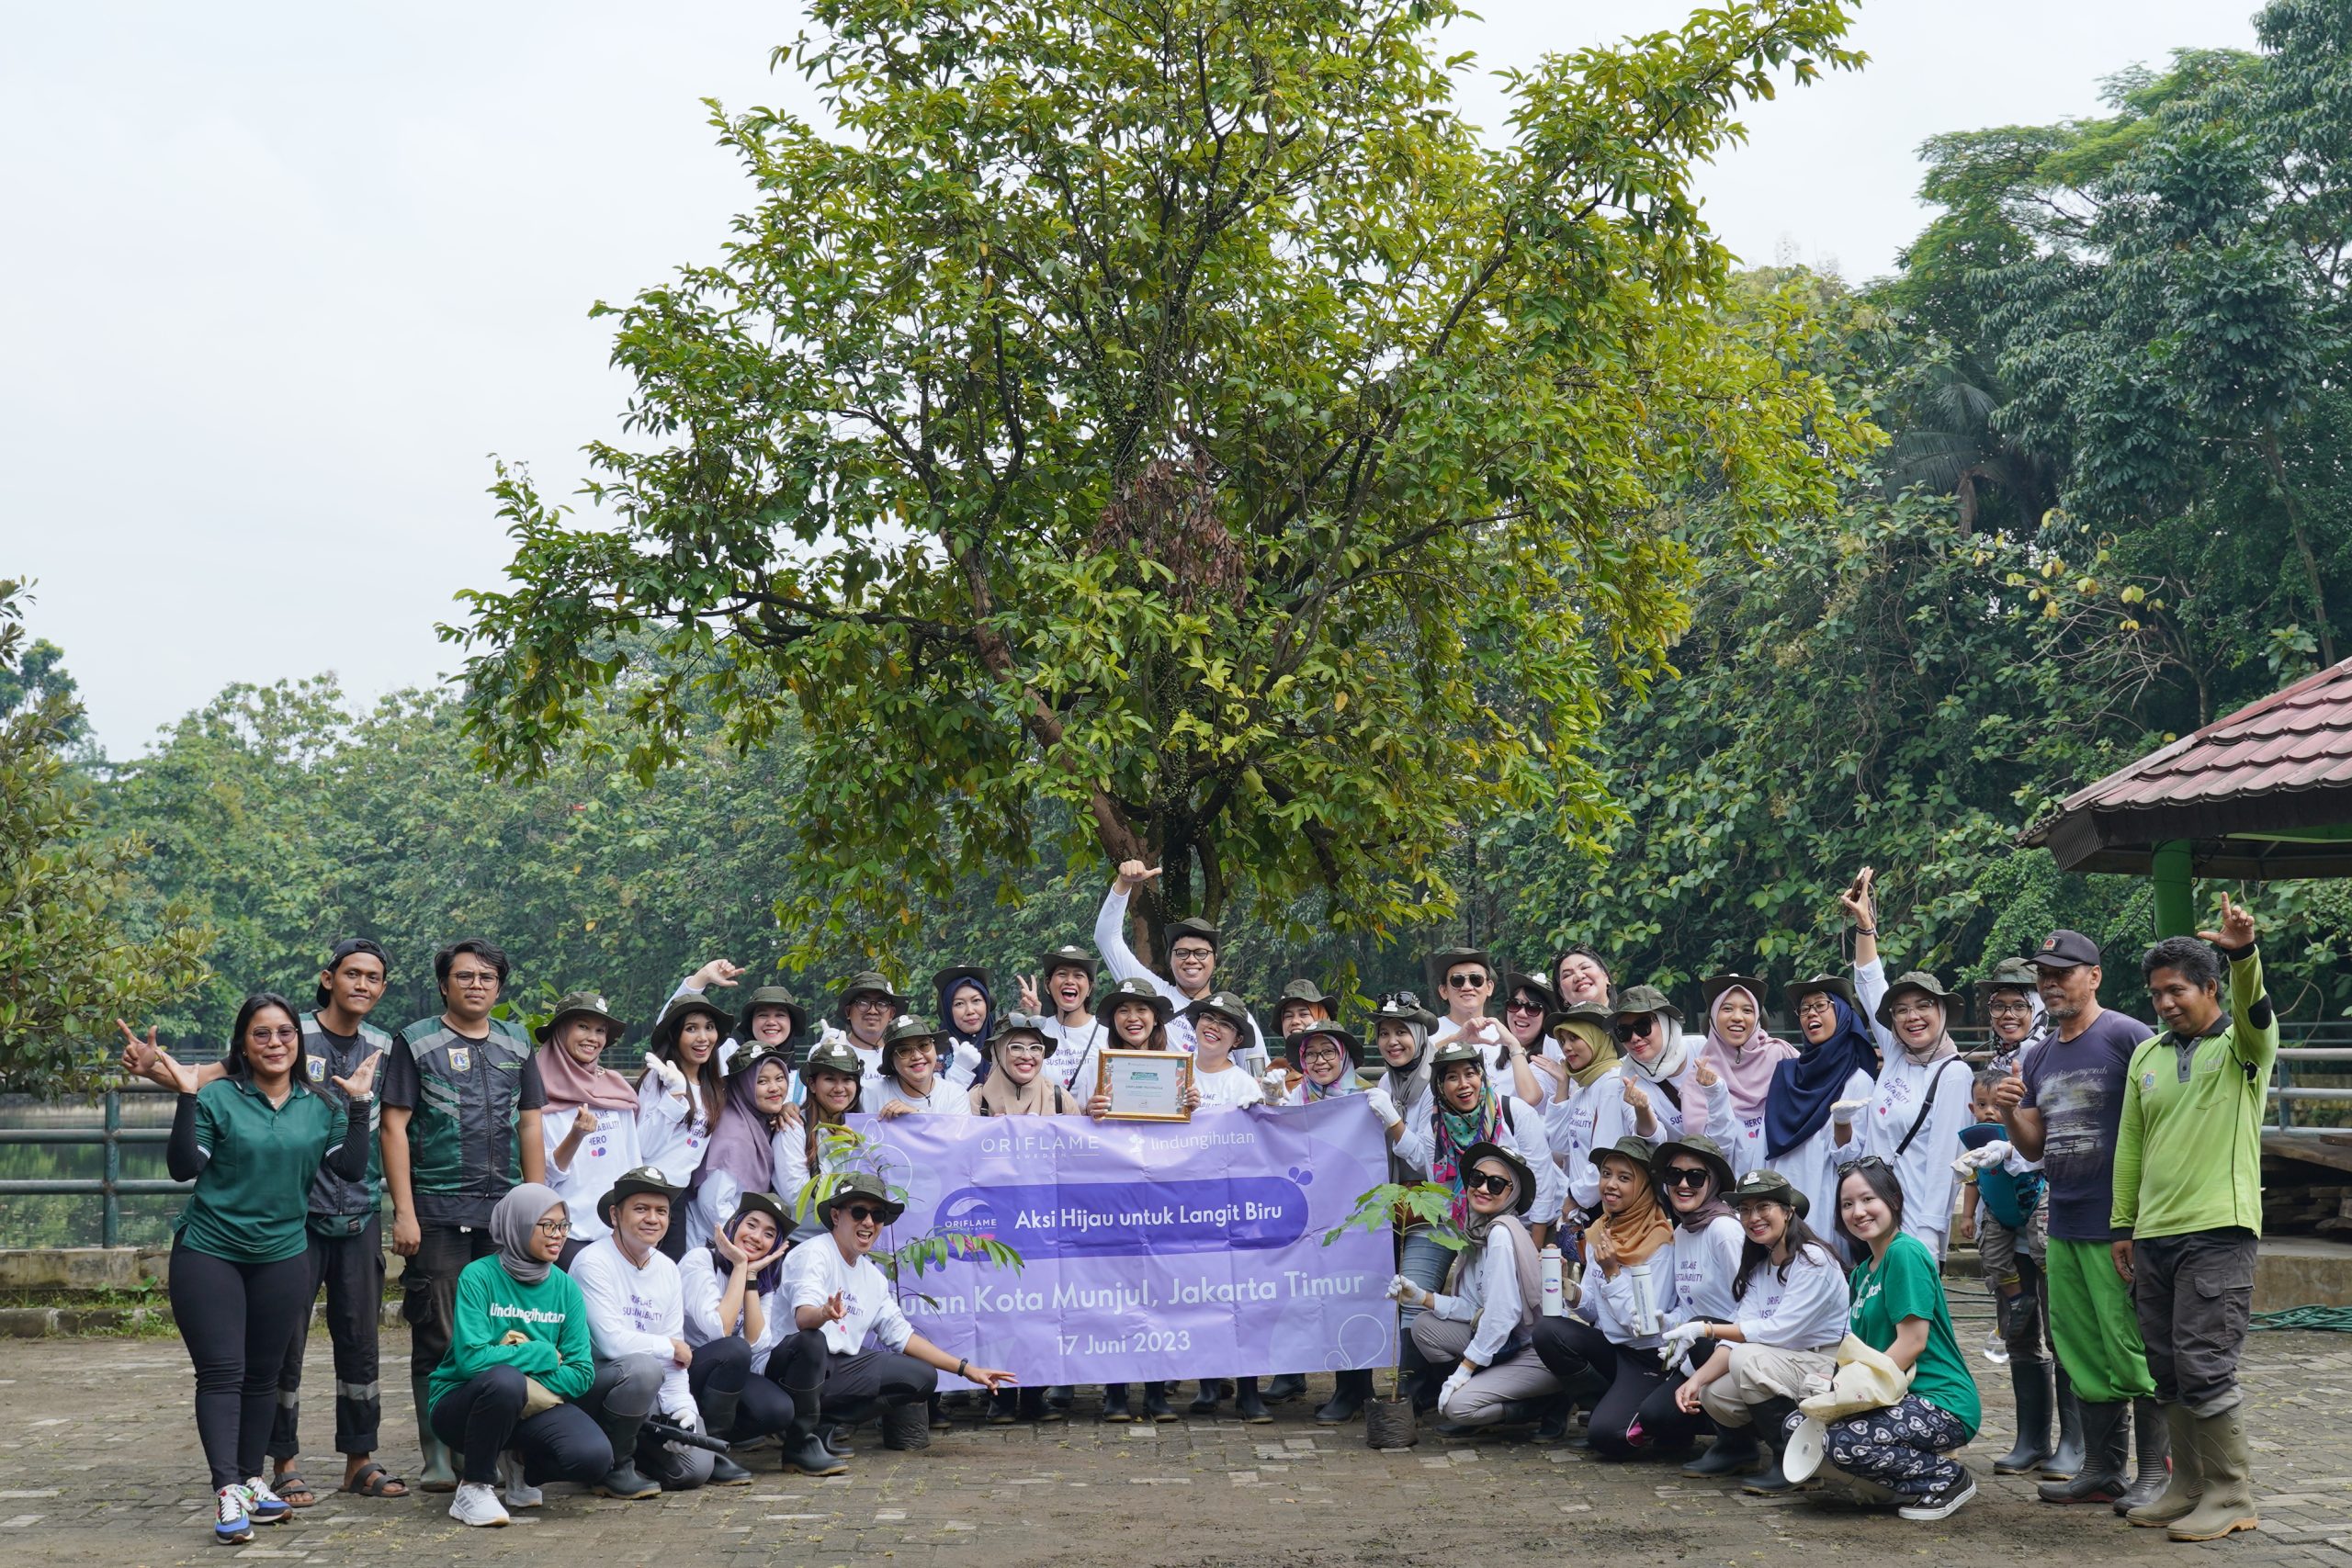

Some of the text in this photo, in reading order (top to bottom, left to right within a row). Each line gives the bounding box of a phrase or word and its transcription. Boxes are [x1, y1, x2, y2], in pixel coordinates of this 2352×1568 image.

[1744, 1116, 1762, 1129] HERO
[980, 1135, 1100, 1153] ORIFLAME
[1150, 1131, 1255, 1150] lindungihutan
[944, 1218, 997, 1228] ORIFLAME
[1014, 1201, 1282, 1233] Aksi Hijau untuk Langit Biru
[891, 1290, 965, 1316] utan
[975, 1285, 1043, 1313] Kota
[1052, 1279, 1159, 1315] Munjul,
[1169, 1276, 1277, 1304] Jakarta
[1284, 1270, 1364, 1298] Timur
[490, 1303, 566, 1324] lindungihutan
[1057, 1330, 1191, 1356] 17 Juni 2023
